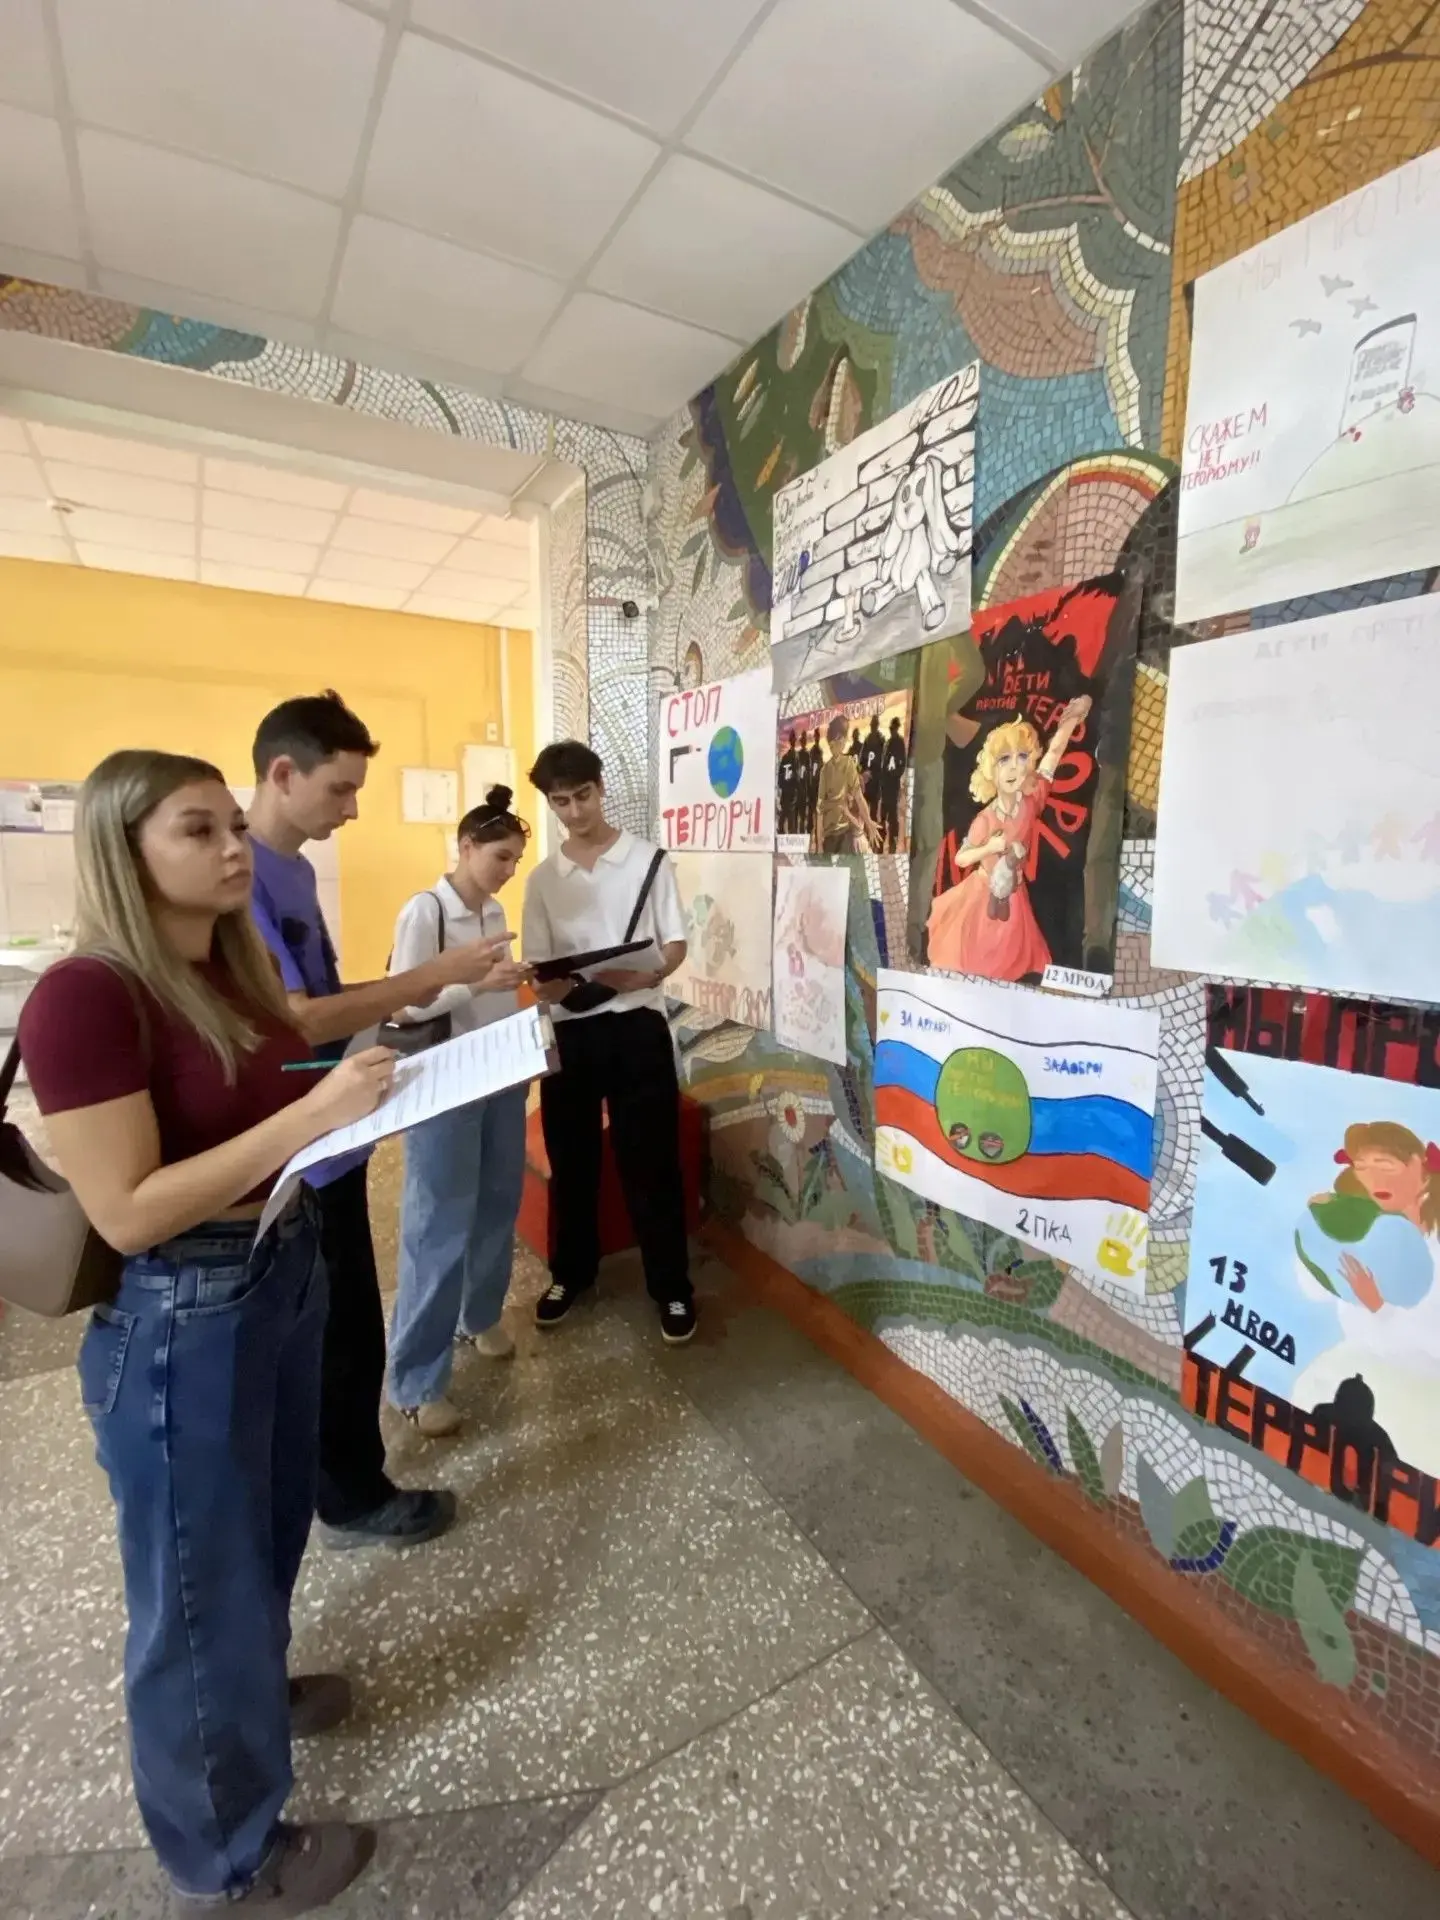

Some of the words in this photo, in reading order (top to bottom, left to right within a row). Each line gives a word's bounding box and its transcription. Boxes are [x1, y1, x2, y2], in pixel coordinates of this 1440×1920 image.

[1187, 401, 1268, 454] СКАЖЕМ
[1003, 671, 1051, 695] ДЕТИ
[667, 685, 722, 738] СТОП
[1046, 968, 1059, 982] 12
[1209, 1255, 1248, 1294] 13
